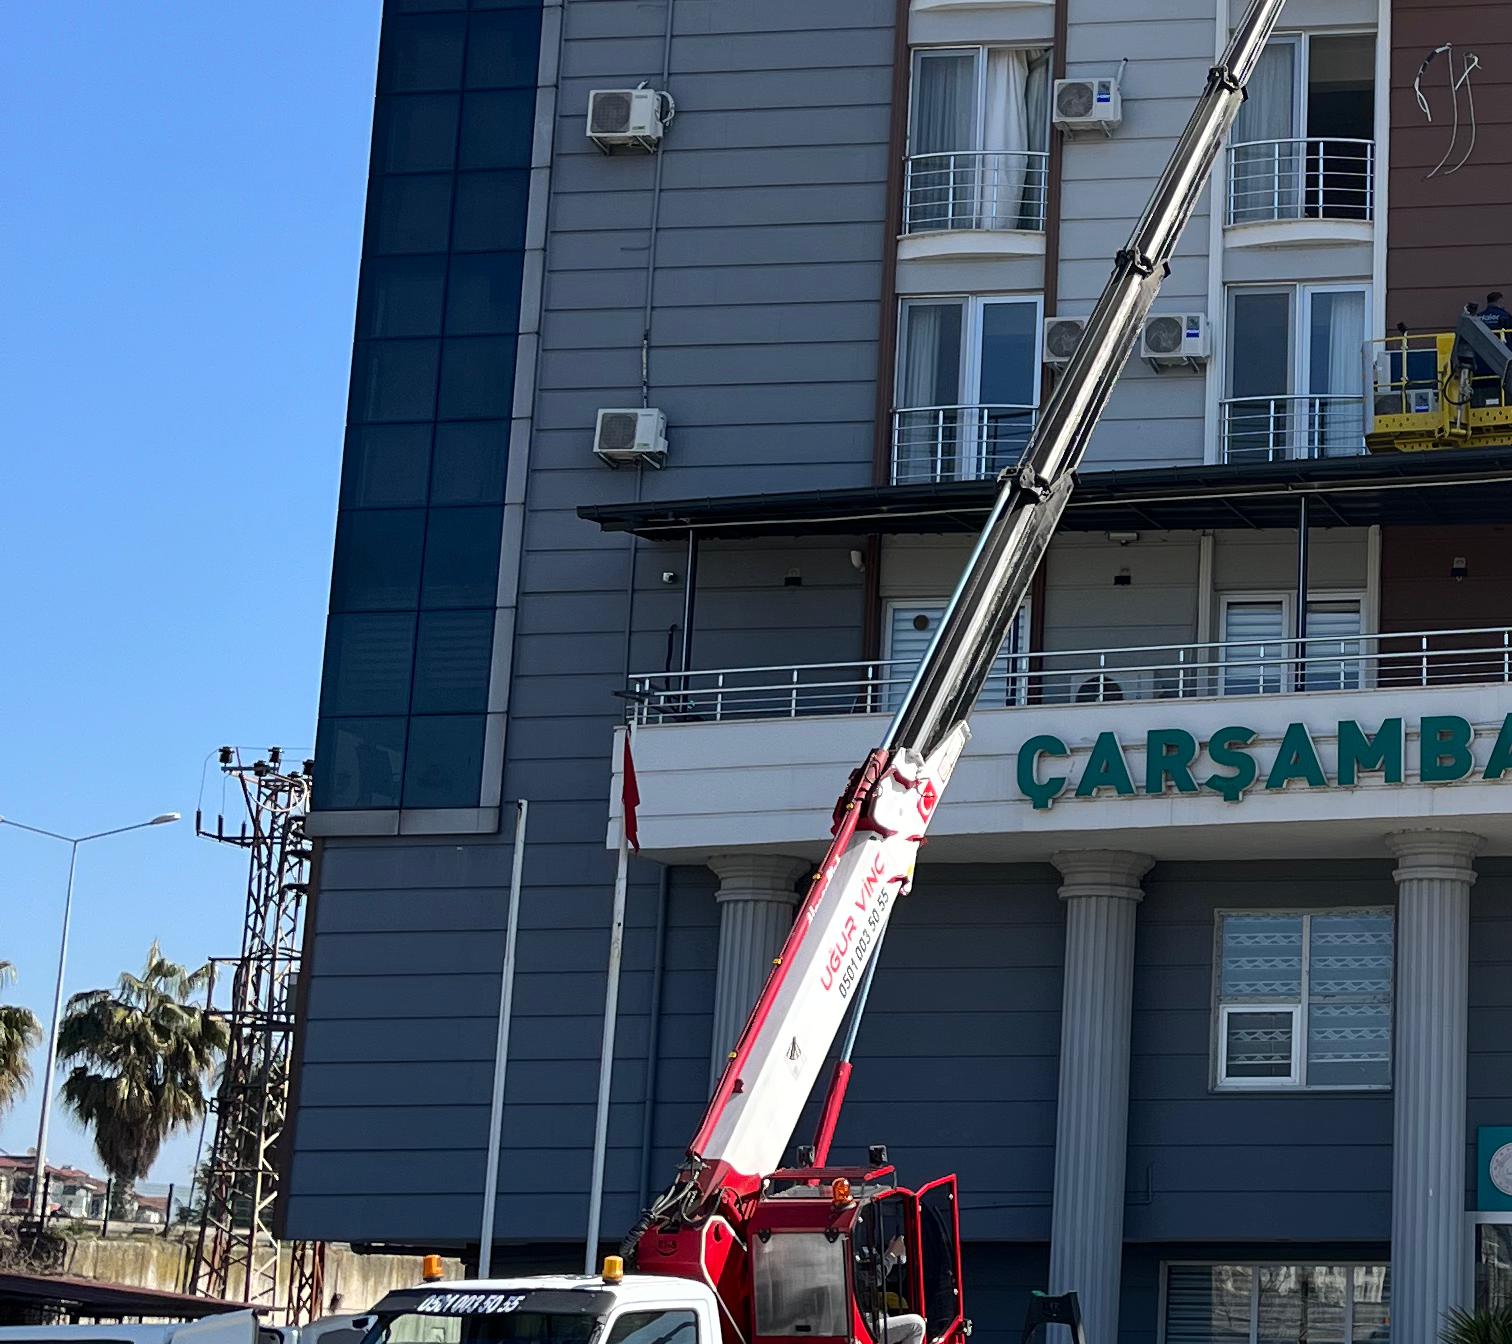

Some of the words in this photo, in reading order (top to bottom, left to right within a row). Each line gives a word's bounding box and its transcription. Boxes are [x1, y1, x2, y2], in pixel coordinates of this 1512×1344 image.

[820, 915, 858, 991] UĞUR
[839, 957, 858, 998] 0501
[855, 929, 871, 962] 003
[868, 909, 880, 931] 50
[877, 887, 889, 911] 55
